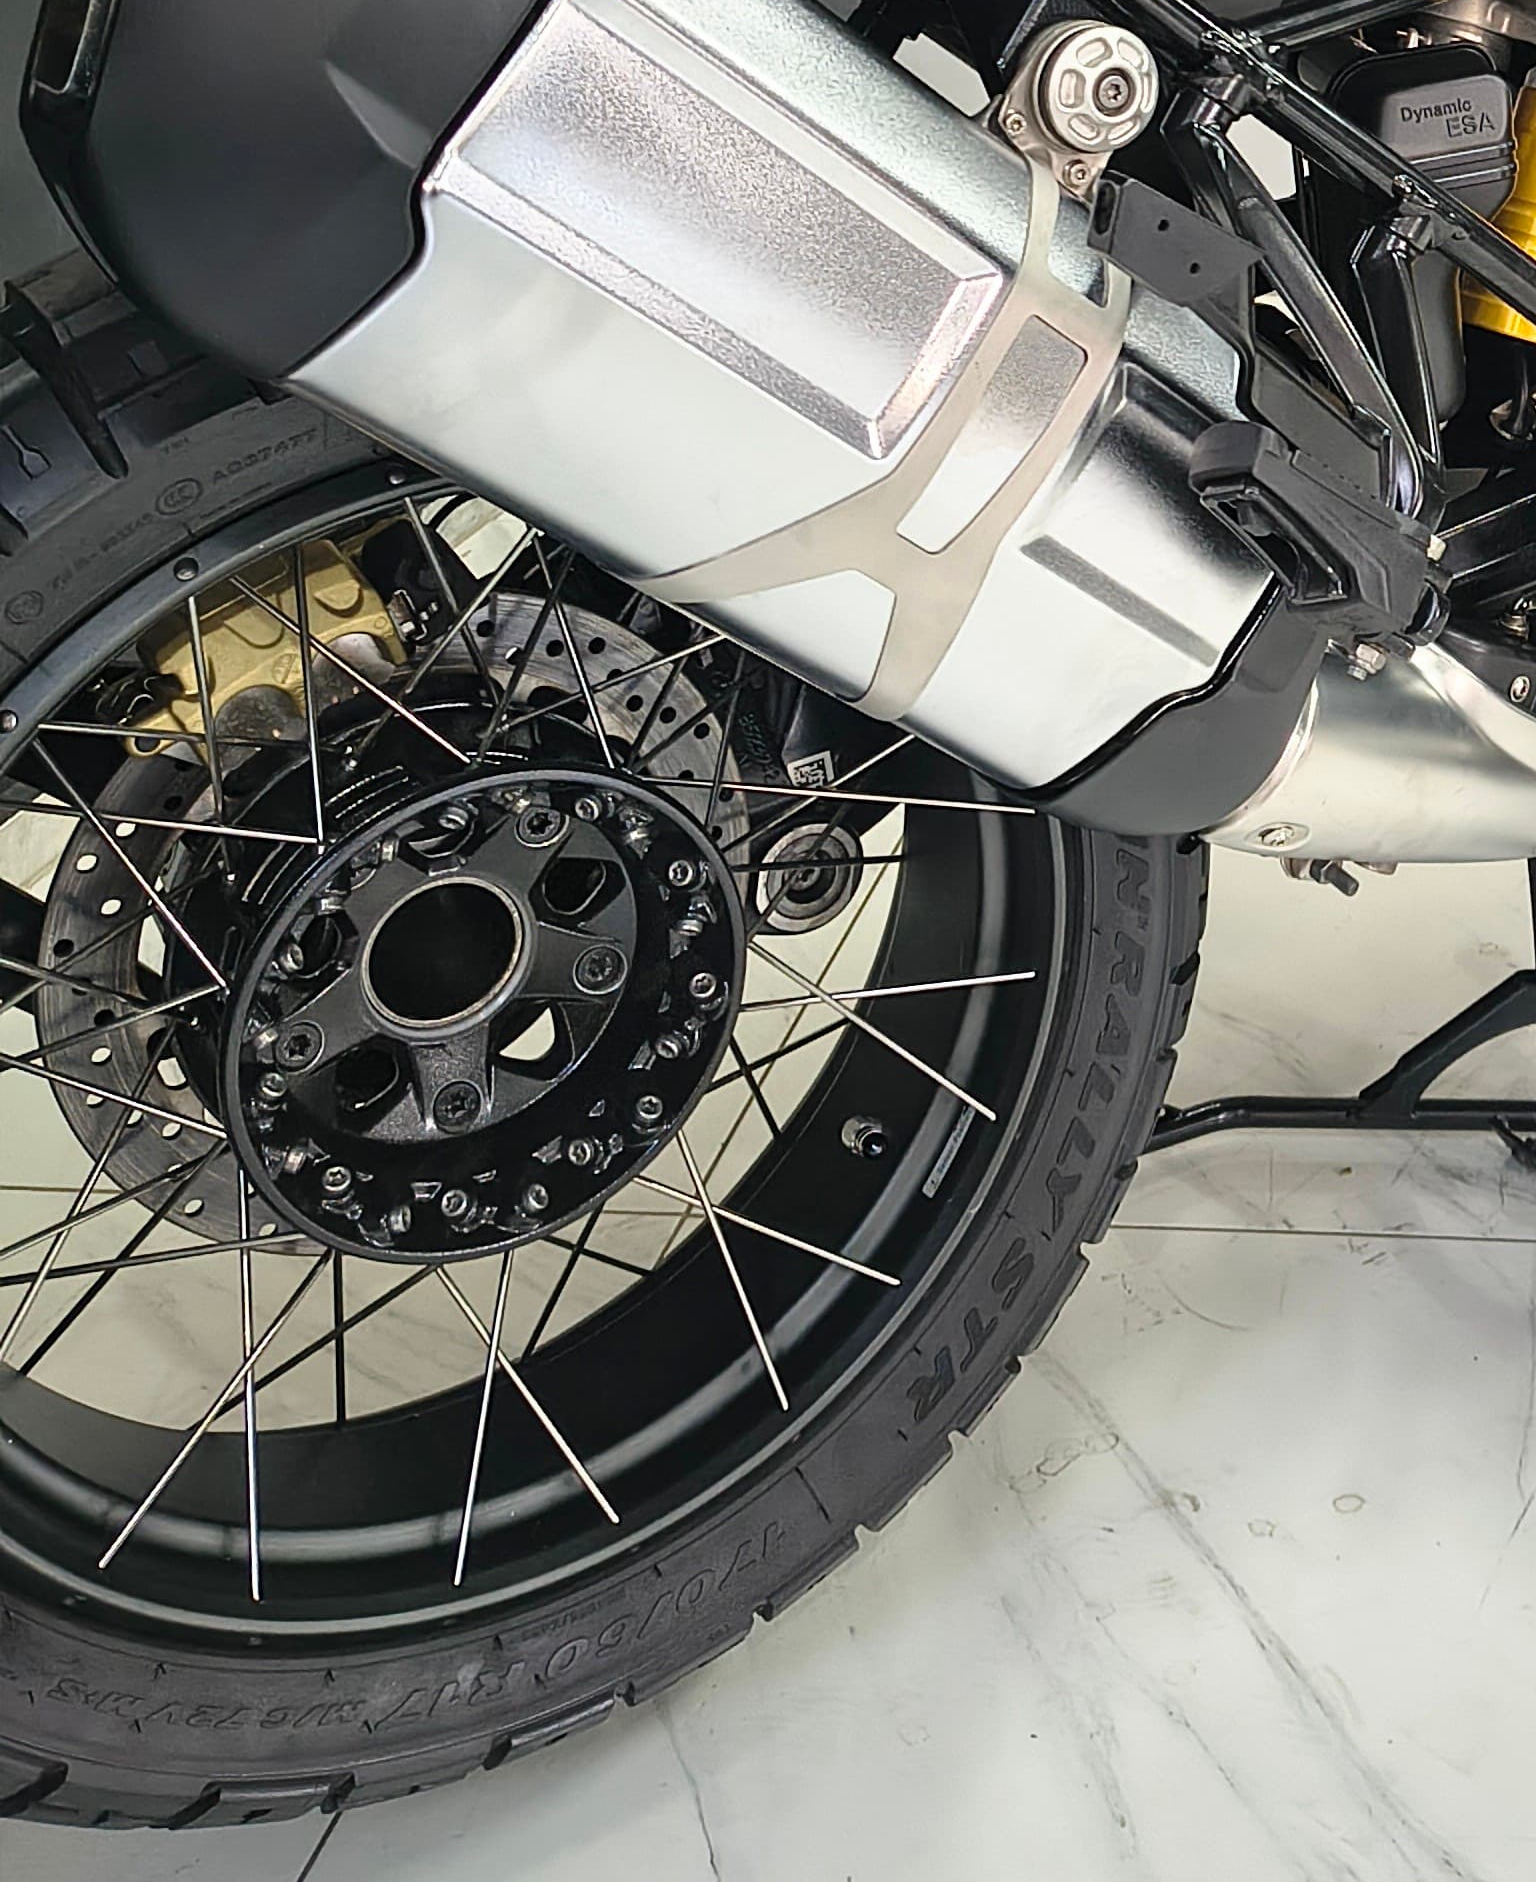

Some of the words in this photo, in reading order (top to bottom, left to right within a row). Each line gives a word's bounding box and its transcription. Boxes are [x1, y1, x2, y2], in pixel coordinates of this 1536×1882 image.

[1400, 97, 1472, 124] Dynamic
[1446, 111, 1496, 138] ESA
[1046, 930, 1148, 1226] RALLY
[908, 1236, 1036, 1425] STR
